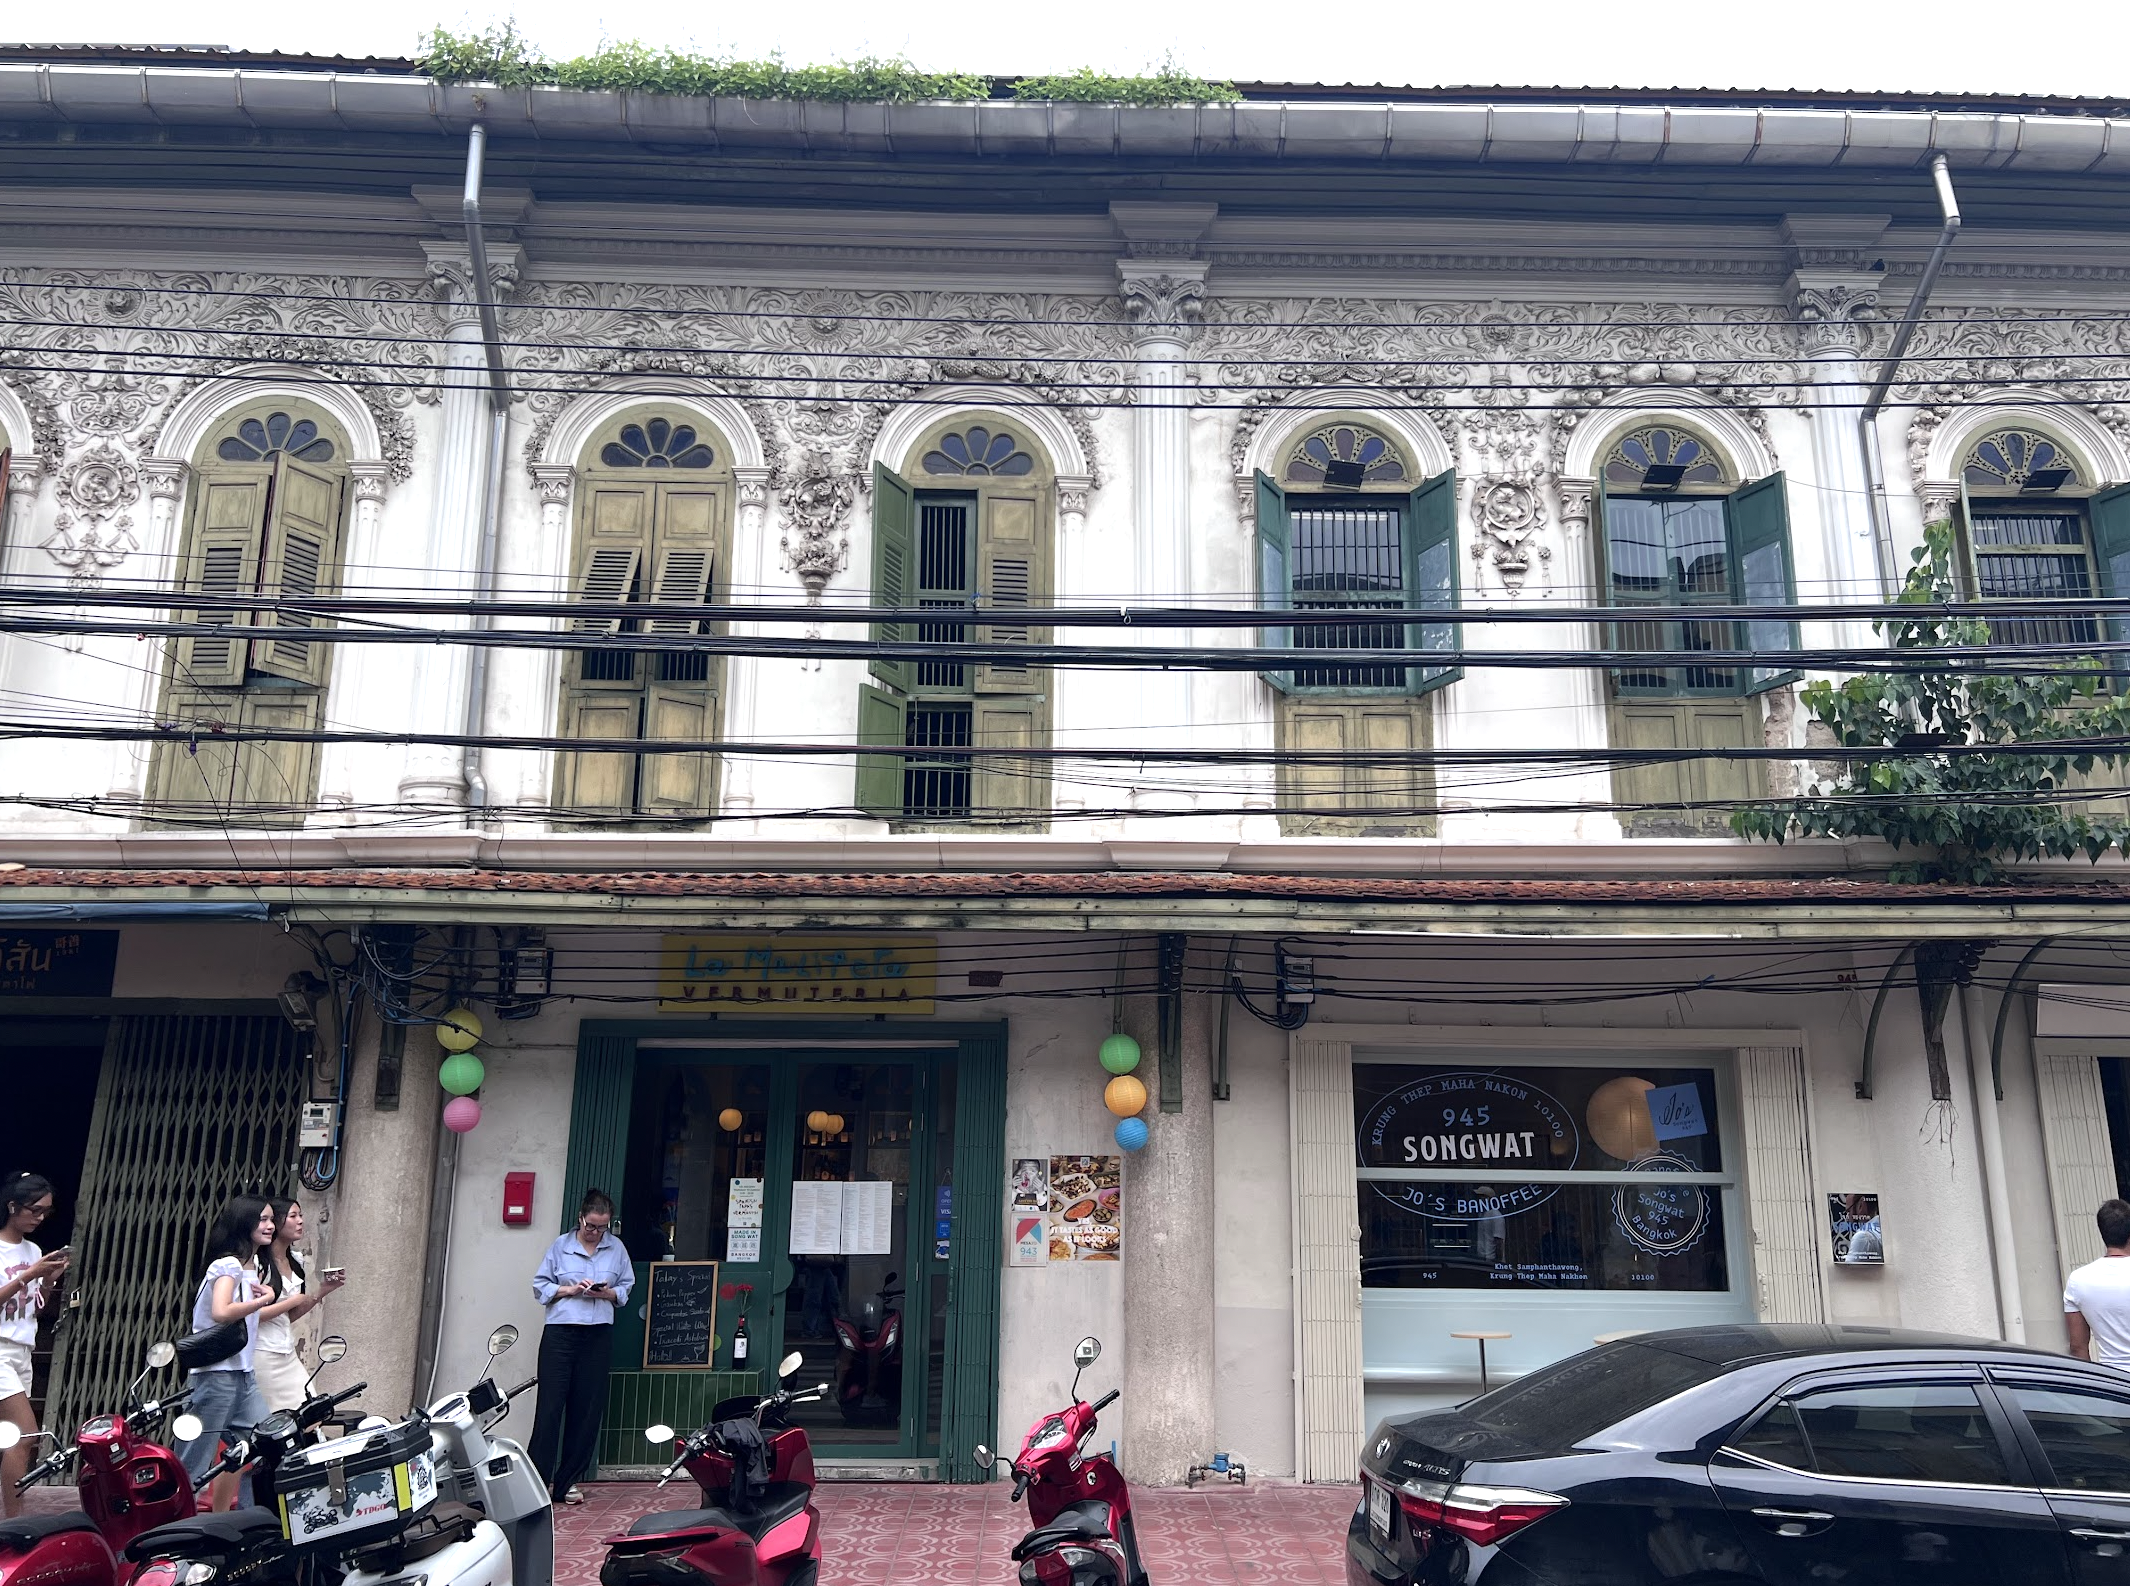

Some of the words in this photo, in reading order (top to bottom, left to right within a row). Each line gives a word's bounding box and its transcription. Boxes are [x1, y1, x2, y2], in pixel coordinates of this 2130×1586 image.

[683, 986, 910, 1002] VERMUTERIA
[1371, 1105, 1398, 1146] KRUNG
[1400, 1085, 1433, 1105] THEP
[1441, 1079, 1477, 1092] MAHA
[1485, 1081, 1529, 1102] NAKON
[1533, 1101, 1565, 1139] 10100
[1442, 1105, 1491, 1127] 945
[1403, 1132, 1535, 1162] SONGWAT
[1457, 1182, 1543, 1213] BANOFFEE
[1653, 1187, 1677, 1203] Jo's
[1637, 1193, 1685, 1219] Songwat
[1648, 1210, 1669, 1226] 945
[1631, 1215, 1678, 1241] Bangkok
[1020, 1247, 1038, 1256] 943
[1422, 1271, 1438, 1280] 945
[1494, 1263, 1513, 1271] Khet
[1516, 1263, 1583, 1273] Samphanthawong,
[1490, 1272, 1513, 1281] Krung
[1516, 1272, 1536, 1281] Thep
[1538, 1272, 1558, 1280] Maha
[1560, 1272, 1589, 1280] Nakhon
